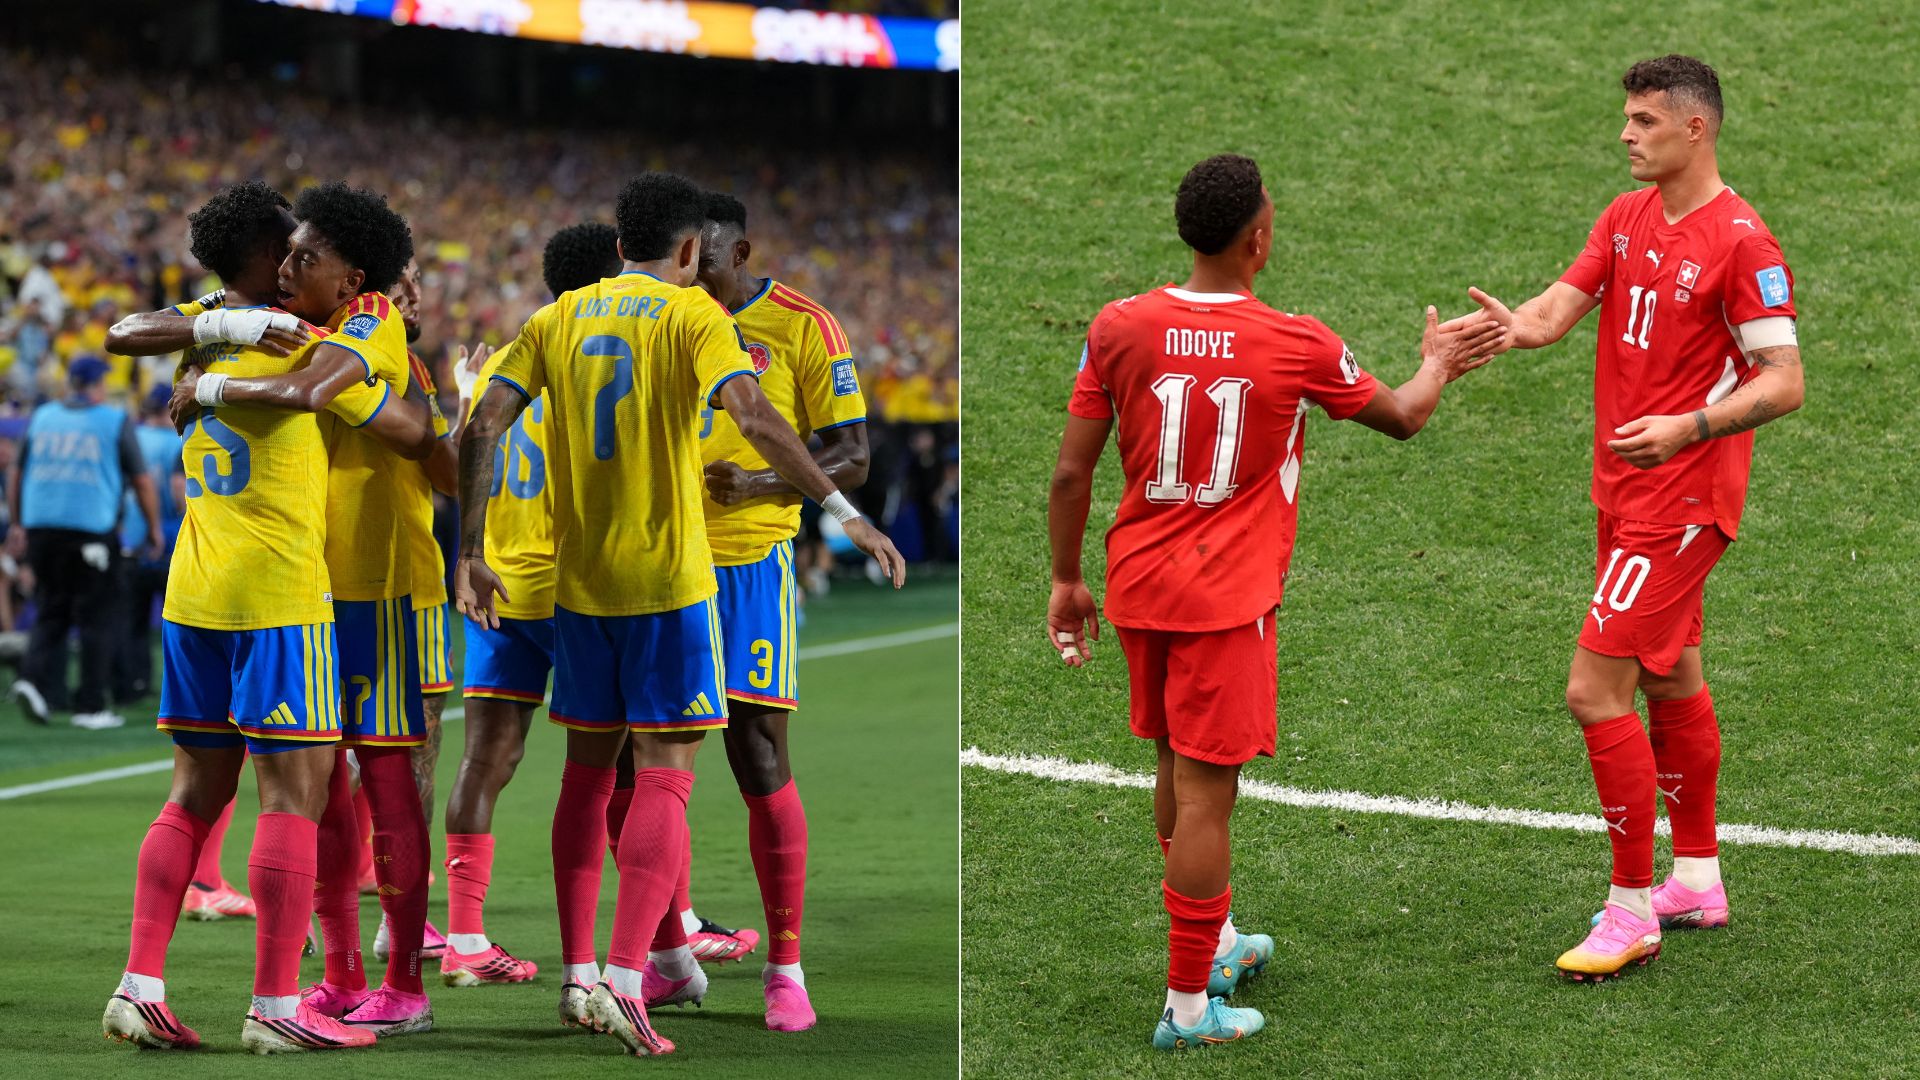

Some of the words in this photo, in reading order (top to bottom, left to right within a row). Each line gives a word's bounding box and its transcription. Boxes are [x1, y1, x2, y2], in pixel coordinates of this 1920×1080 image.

[575, 296, 613, 319] LUIS
[616, 295, 668, 320] DIAZ
[1622, 285, 1658, 350] 10
[1165, 328, 1235, 358] NDOYE
[581, 334, 633, 461] 7
[32, 432, 100, 463] FIFA
[1146, 372, 1255, 508] 11
[1592, 548, 1652, 611] 10
[748, 639, 774, 689] 3
